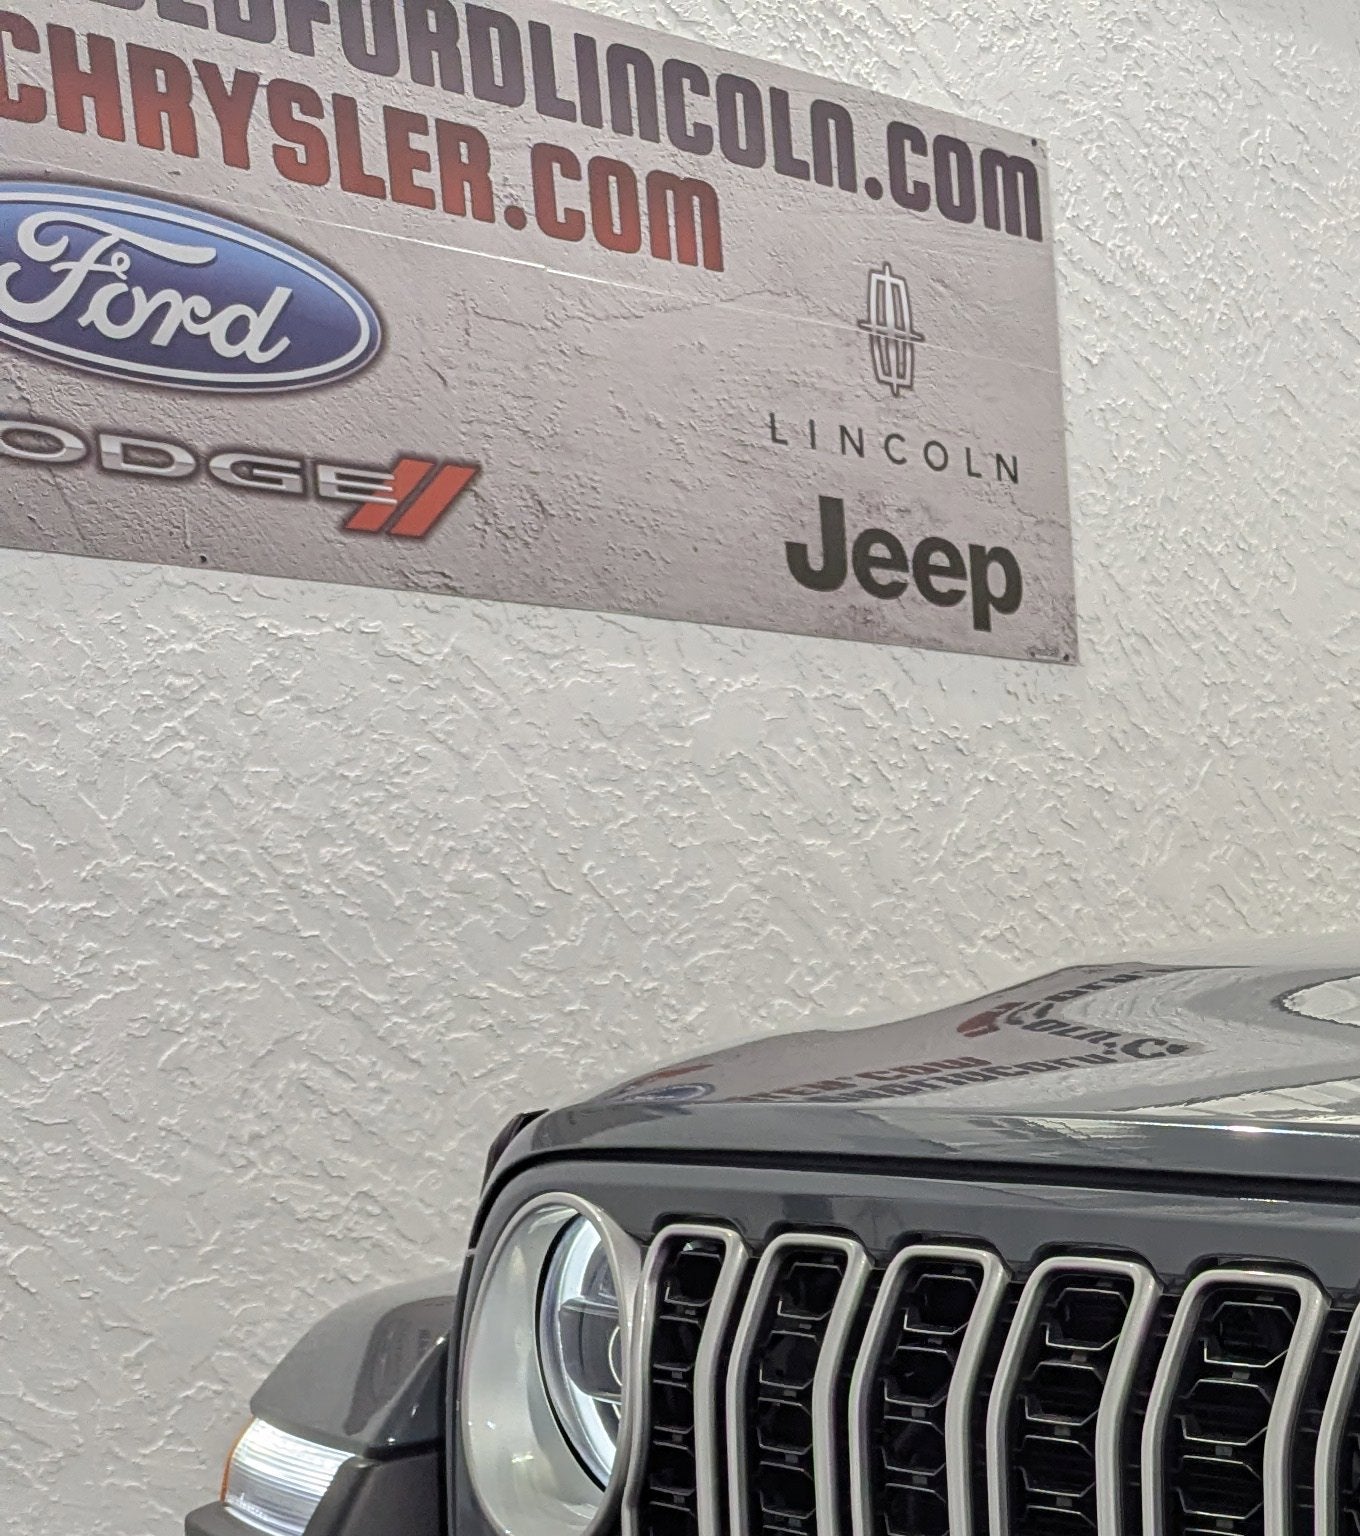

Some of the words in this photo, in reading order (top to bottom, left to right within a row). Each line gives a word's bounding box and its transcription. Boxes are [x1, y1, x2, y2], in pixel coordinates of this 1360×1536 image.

[90, 0, 1043, 242] FORDLINCOLN.COM
[0, 212, 292, 366] Ford
[768, 411, 1020, 485] LINCOLN
[786, 495, 1022, 632] Jeep
